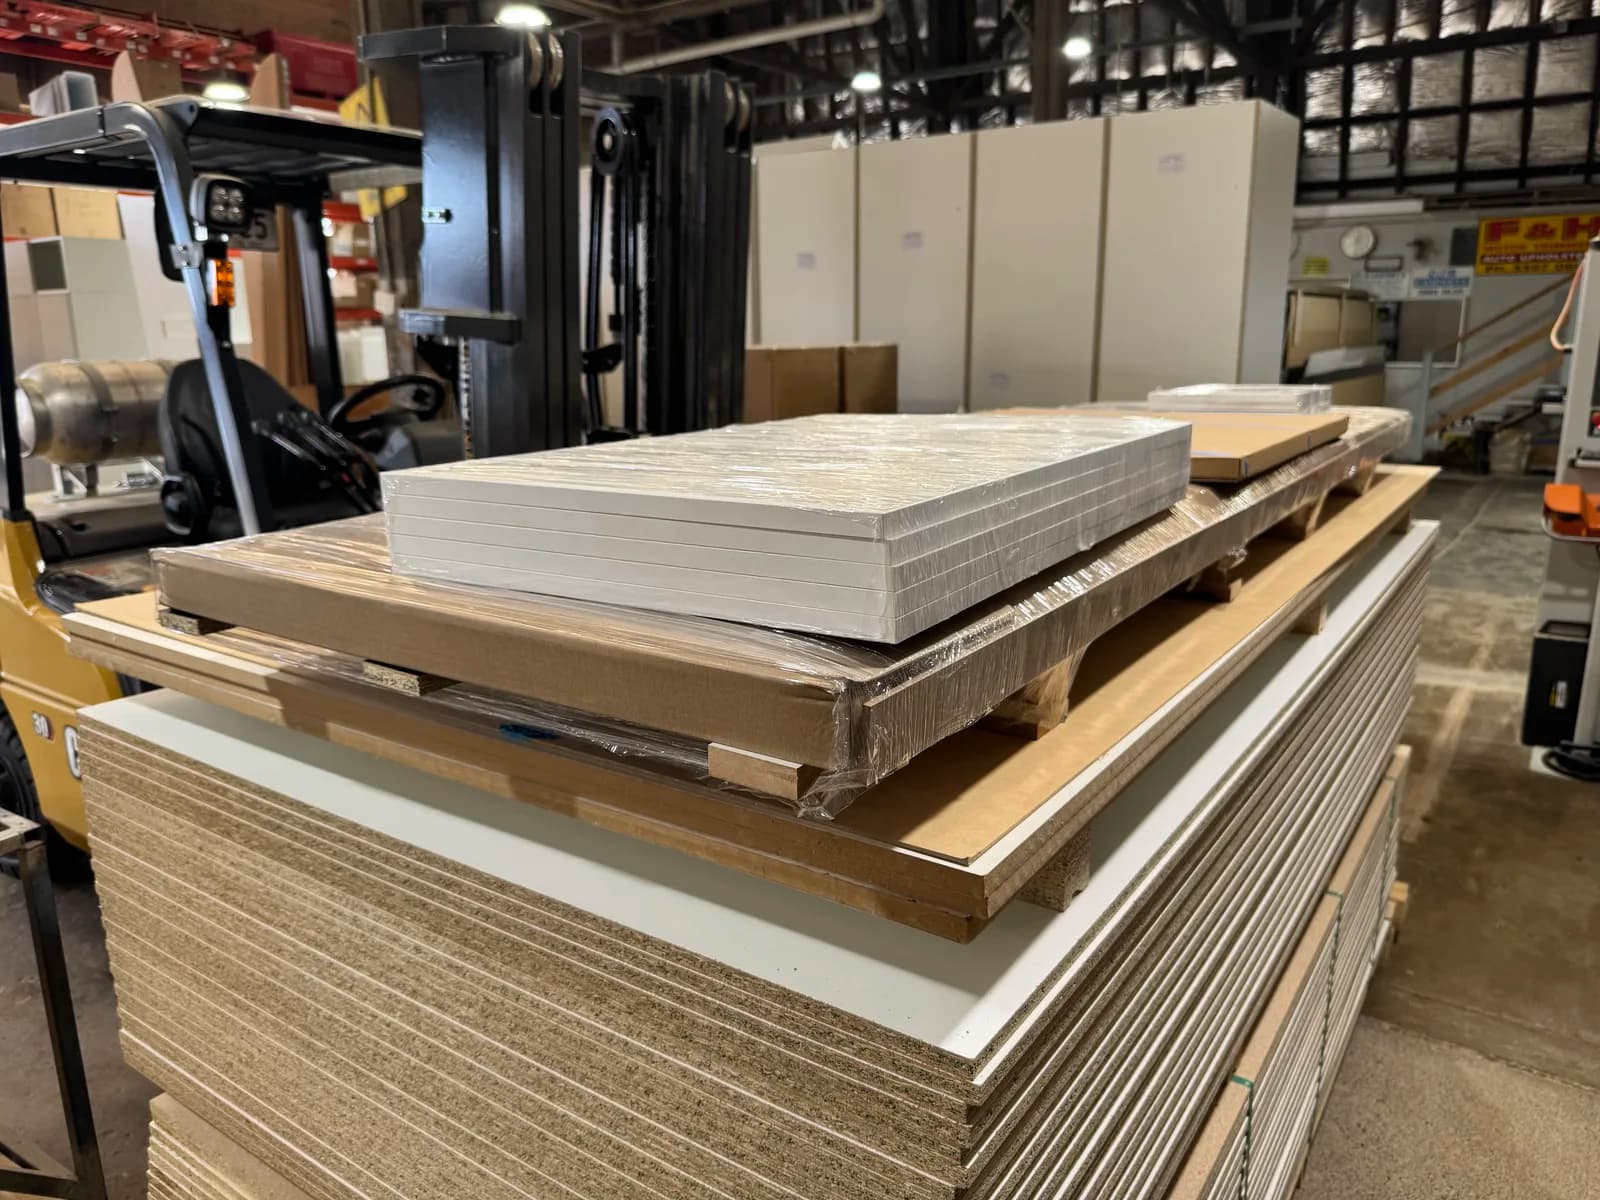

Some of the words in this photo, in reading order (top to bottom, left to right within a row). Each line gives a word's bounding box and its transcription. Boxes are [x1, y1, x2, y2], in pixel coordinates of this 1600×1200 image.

[1485, 219, 1520, 242] F
[1524, 222, 1557, 240] &
[1562, 215, 1600, 241] H
